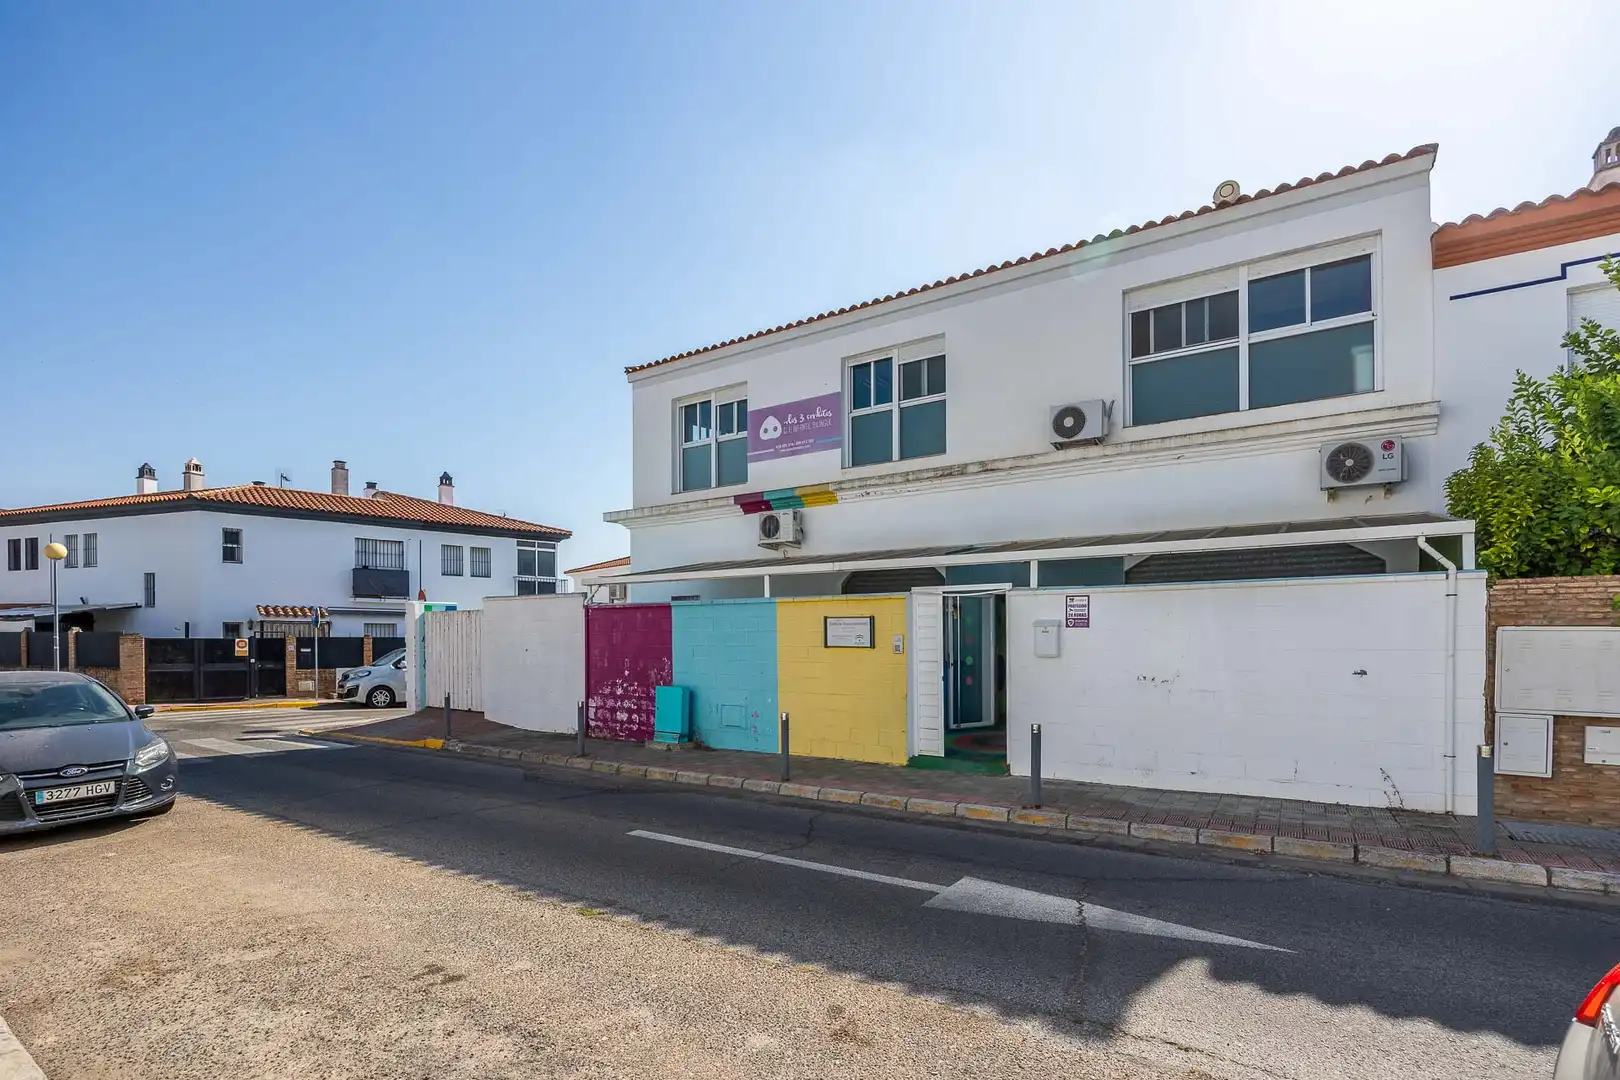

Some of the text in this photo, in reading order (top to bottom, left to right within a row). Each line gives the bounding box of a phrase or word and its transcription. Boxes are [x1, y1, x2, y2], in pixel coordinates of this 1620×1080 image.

[799, 413, 805, 422] 3
[46, 783, 111, 801] 3277 HGV
